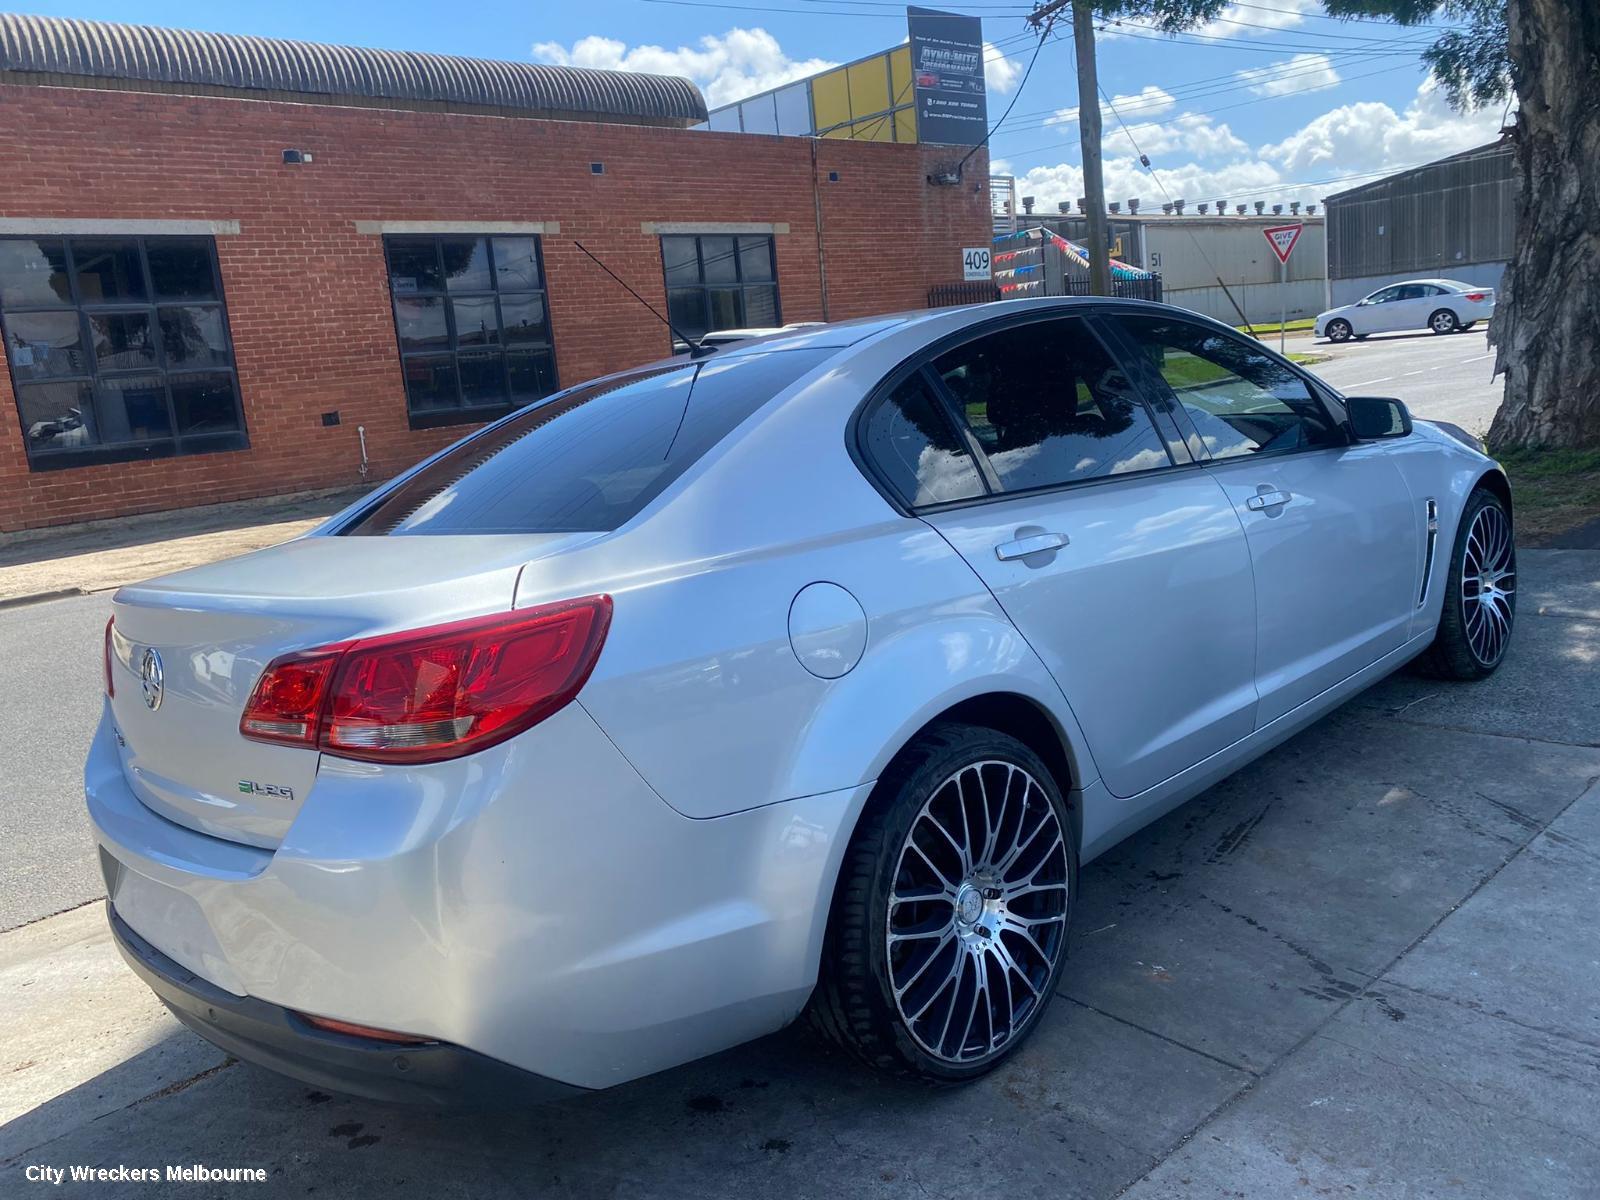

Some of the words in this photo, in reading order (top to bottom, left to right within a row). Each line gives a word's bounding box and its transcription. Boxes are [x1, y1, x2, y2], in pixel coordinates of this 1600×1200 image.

[1274, 231, 1293, 241] GIVE
[965, 251, 989, 270] 409
[1151, 252, 1162, 267] 51
